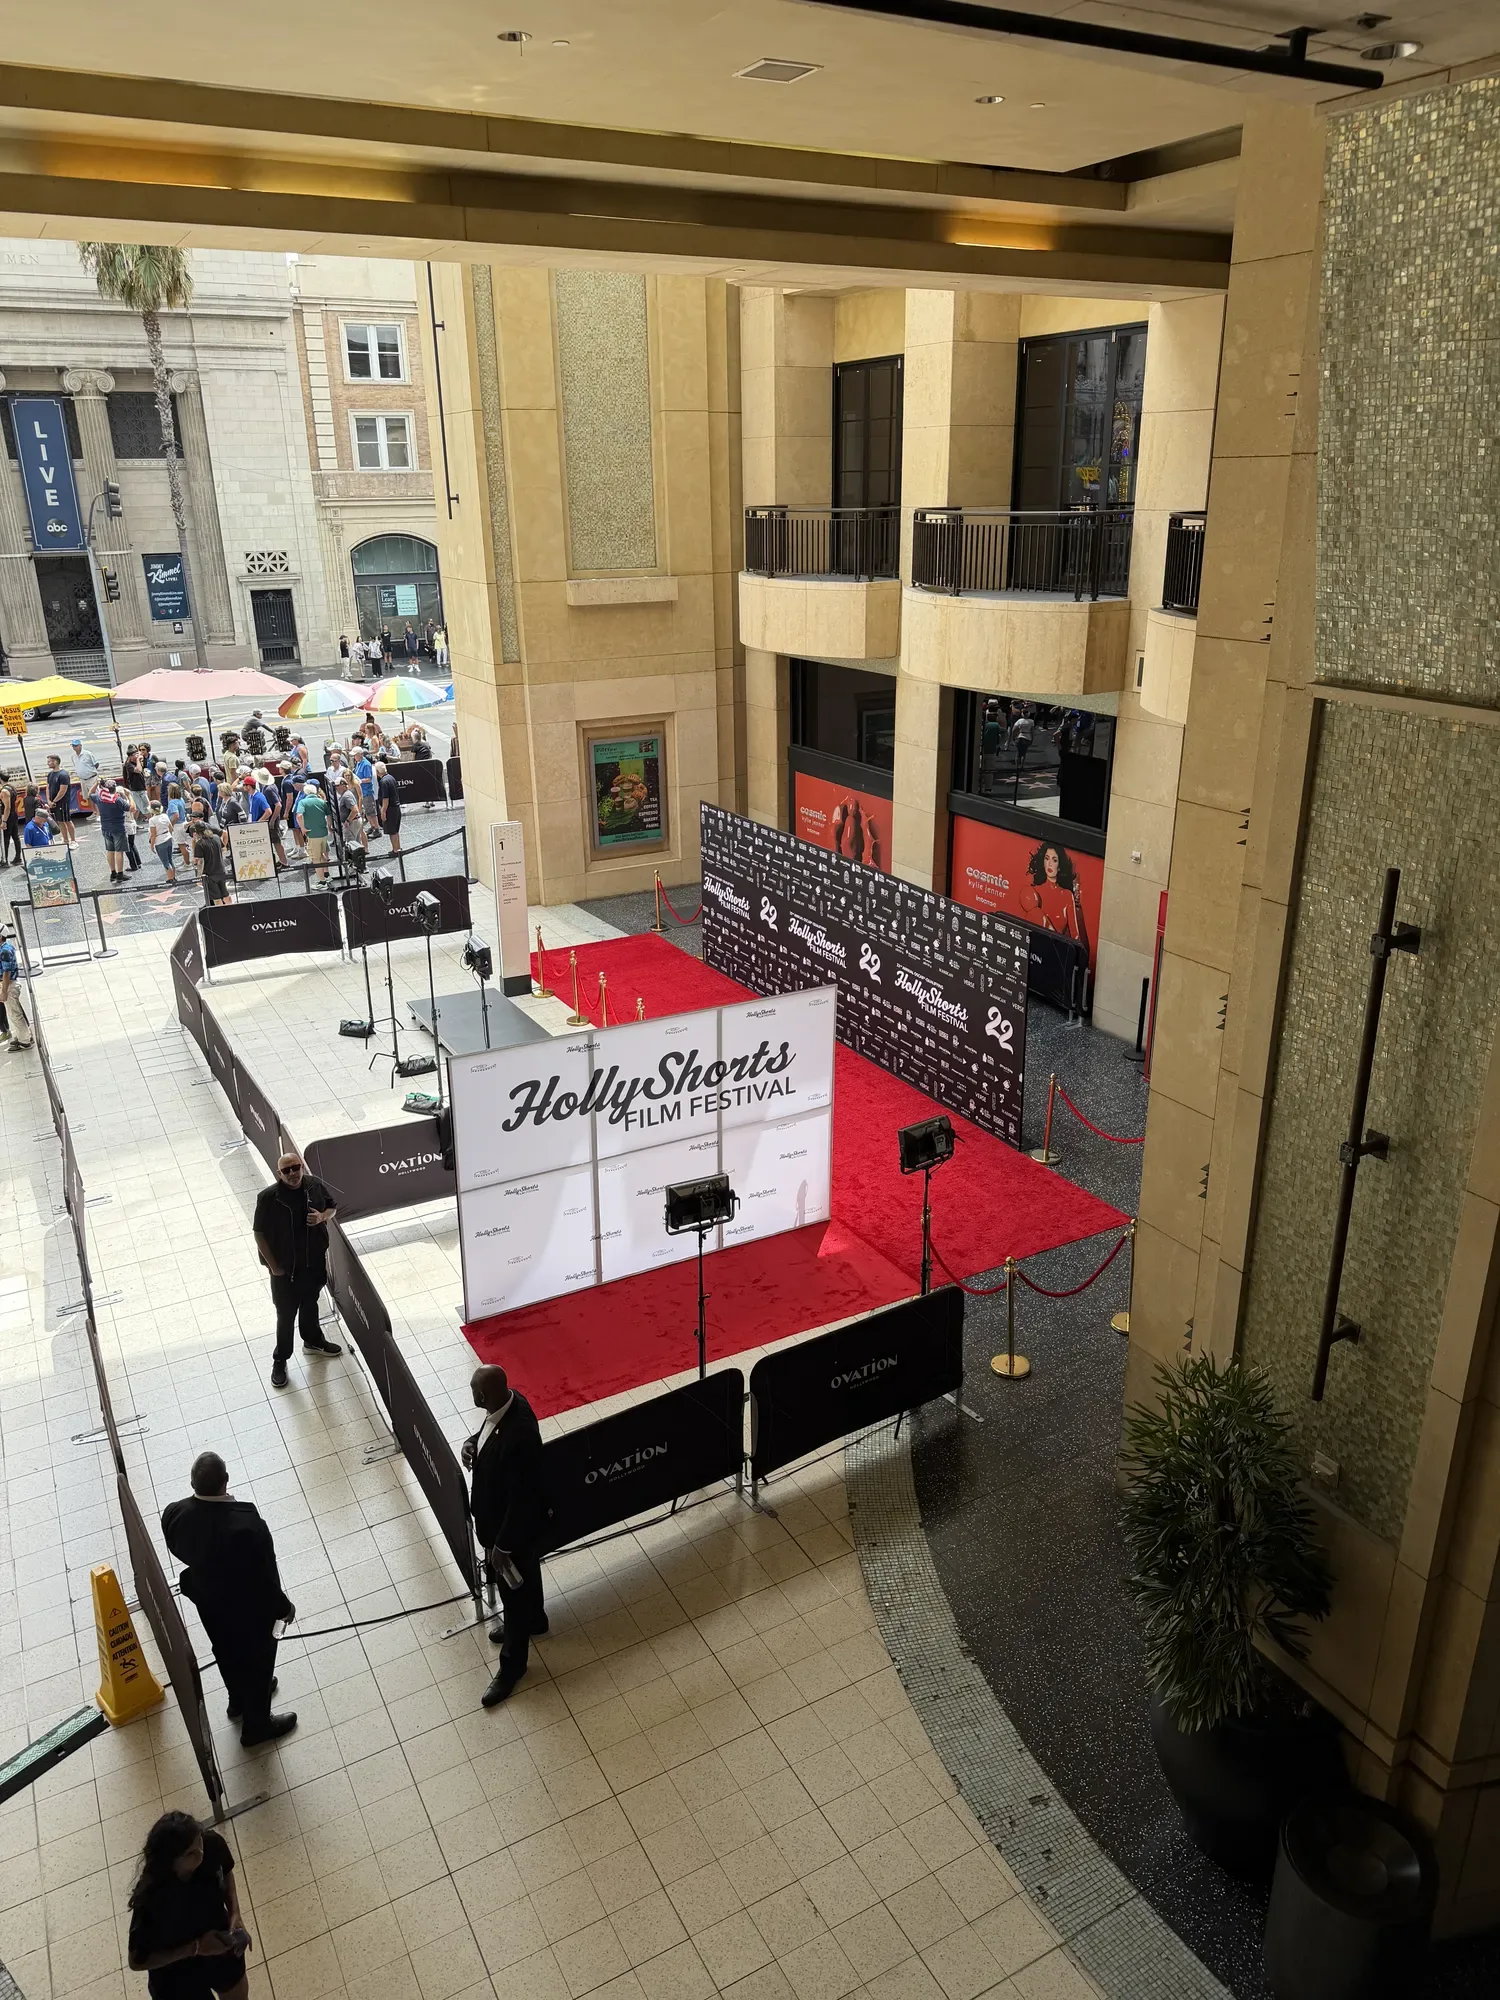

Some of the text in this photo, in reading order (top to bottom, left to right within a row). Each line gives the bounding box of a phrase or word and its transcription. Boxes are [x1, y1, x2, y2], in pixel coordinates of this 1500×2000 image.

[33, 421, 60, 506] LIVE
[47, 523, 68, 533] abc
[147, 562, 181, 584] Kimmel
[7, 725, 27, 735] HELL
[800, 806, 827, 822] cosmic
[499, 841, 504, 851] 1
[966, 866, 1009, 890] cosmic
[968, 878, 1006, 898] kylie jenner
[703, 876, 750, 911] HollyShorts
[720, 900, 750, 920] FILM FESTIVAL
[760, 895, 778, 933] 22
[251, 918, 297, 932] OVATION
[788, 917, 847, 958] HollyShorts
[809, 943, 847, 969] FILM FESTIVAL
[859, 942, 881, 986] 22
[894, 970, 969, 1021] HollyShorts
[921, 1001, 969, 1033] FILM FESTIVAL
[1011, 1002, 1024, 1013] VERSE
[985, 1005, 1014, 1055] 22
[501, 1040, 797, 1132] HollyShorts
[624, 1076, 797, 1132] FILM FESTIVAL
[379, 1152, 443, 1174] OVATION
[831, 1354, 898, 1389] OVATION
[584, 1441, 668, 1484] OVATION
[609, 1464, 646, 1482] HOLLYWOOD
[108, 1621, 129, 1638] CAUTION
[110, 1632, 134, 1649] CUIDADO
[112, 1641, 138, 1661] ATTENTION
